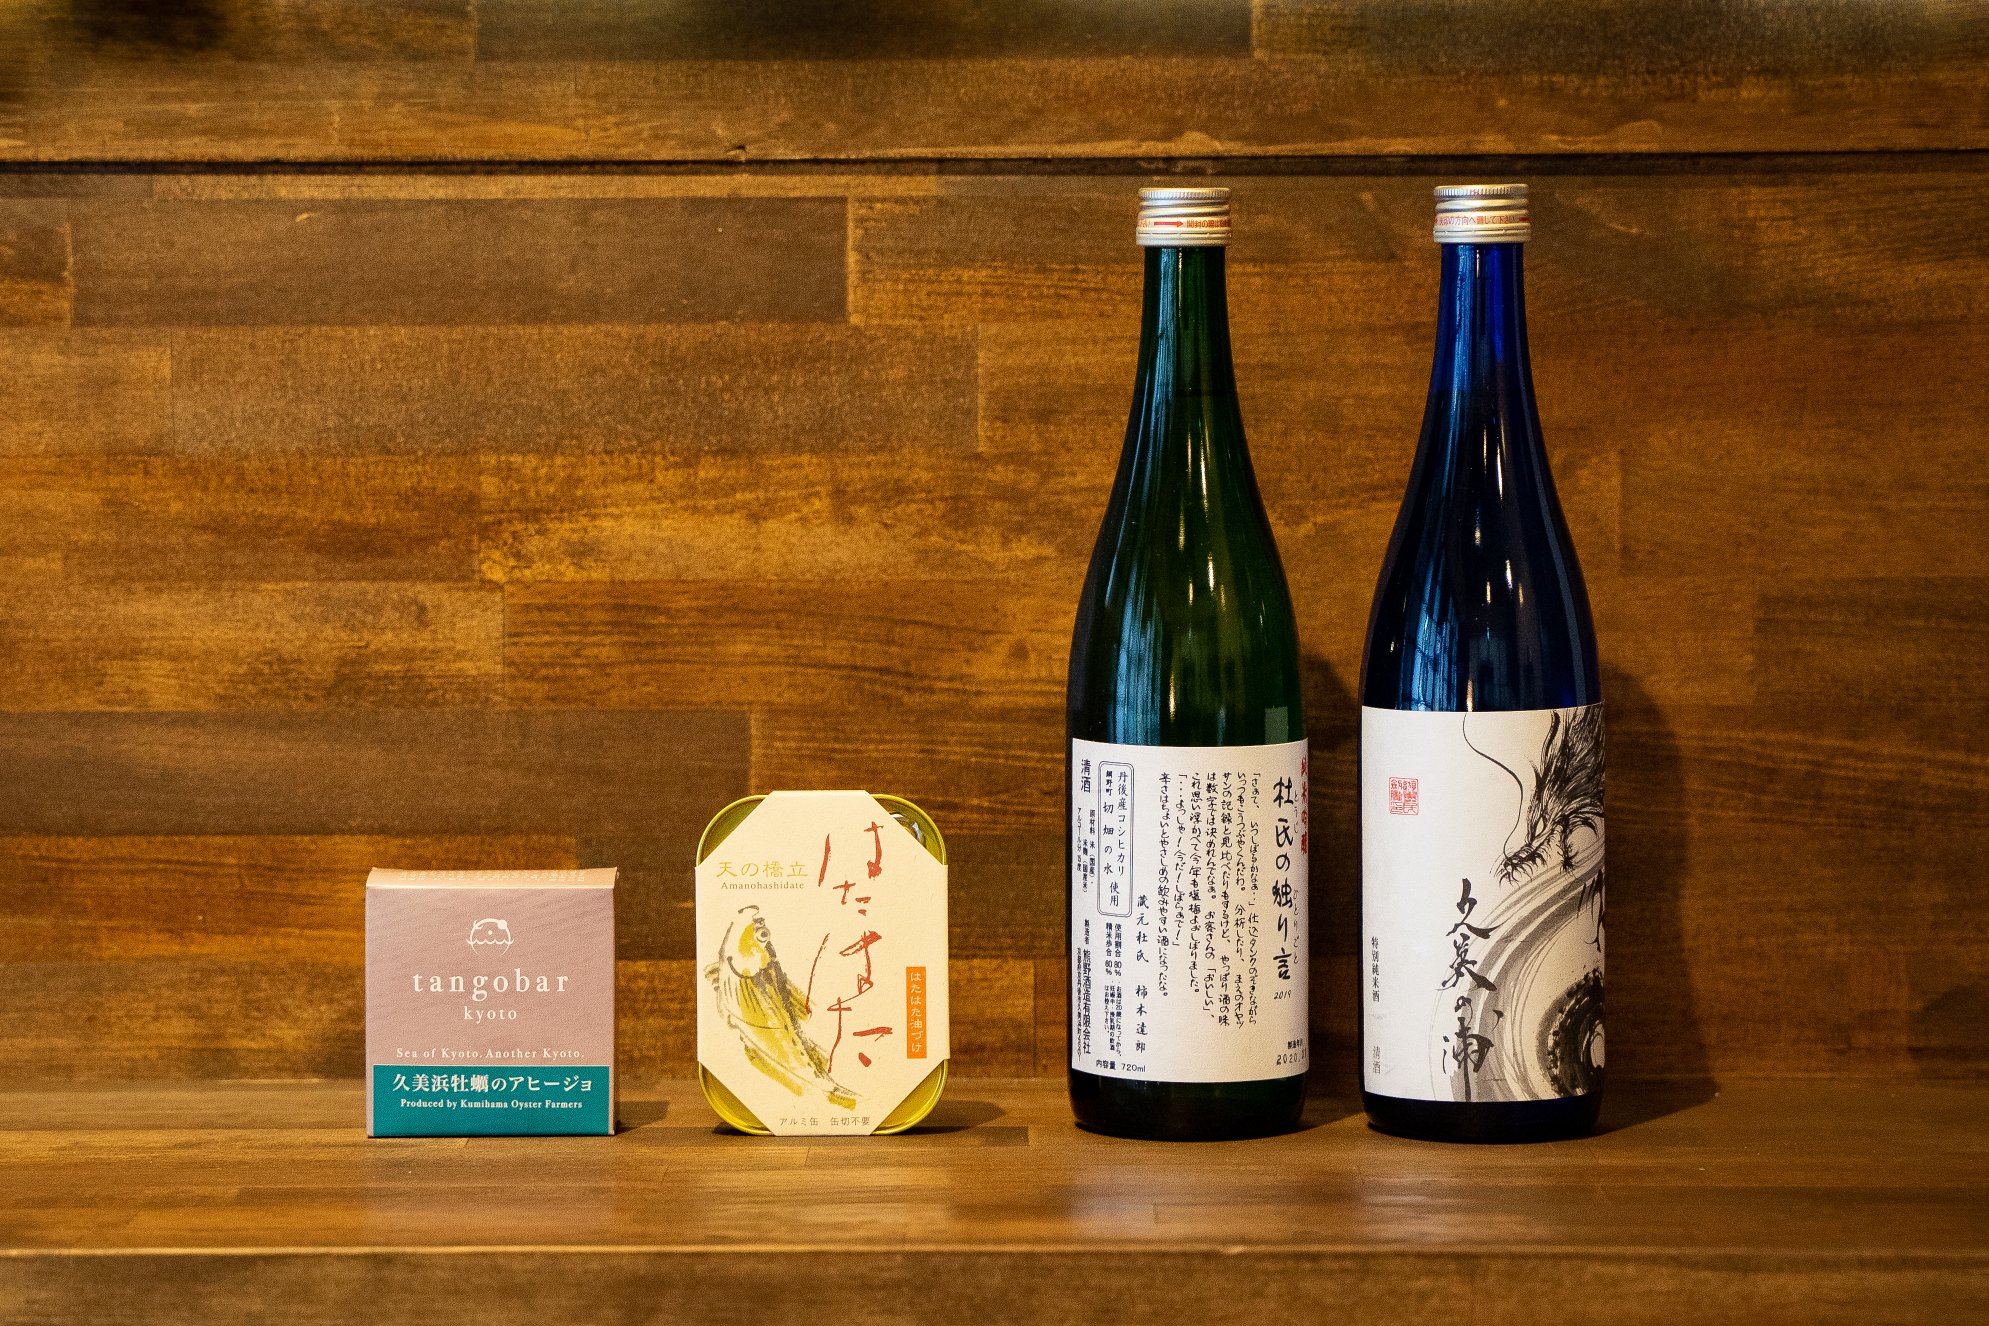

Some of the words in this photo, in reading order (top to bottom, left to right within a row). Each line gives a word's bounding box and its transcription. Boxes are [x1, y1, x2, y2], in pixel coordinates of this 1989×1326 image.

[1080, 758, 1092, 794] 清酒
[1116, 771, 1129, 877] 丹後産コシヒカリ
[715, 861, 809, 878] 天の橋立
[1272, 776, 1293, 981] 杜氏の独り言
[720, 880, 805, 890] Amanohashidate
[1109, 881, 1120, 907] 使用
[1371, 936, 1380, 1003] 特別純米酒
[412, 968, 569, 1002] tangobar
[1273, 989, 1292, 1000] 2019
[463, 1005, 517, 1025] kyoto
[909, 971, 924, 1053] はたはた油づけ
[396, 1047, 419, 1058] Sea
[422, 1047, 437, 1059] of
[441, 1047, 483, 1059] Kyoto.
[485, 1047, 538, 1059] Another
[542, 1047, 585, 1061] Kyoto.
[1372, 1045, 1381, 1075] 清酒
[1095, 1059, 1116, 1071] 内容量
[1121, 1062, 1146, 1073] 720ml
[392, 1073, 592, 1093] 久美浜牡蠣のアヒージョ
[400, 1098, 444, 1108] Produced
[446, 1098, 458, 1110] by
[460, 1099, 509, 1109] Kumihama
[510, 1099, 543, 1111] Oyster
[545, 1099, 583, 1109] Farmers
[779, 1116, 819, 1127] アルミ缶
[829, 1116, 871, 1127] 缶切不要
